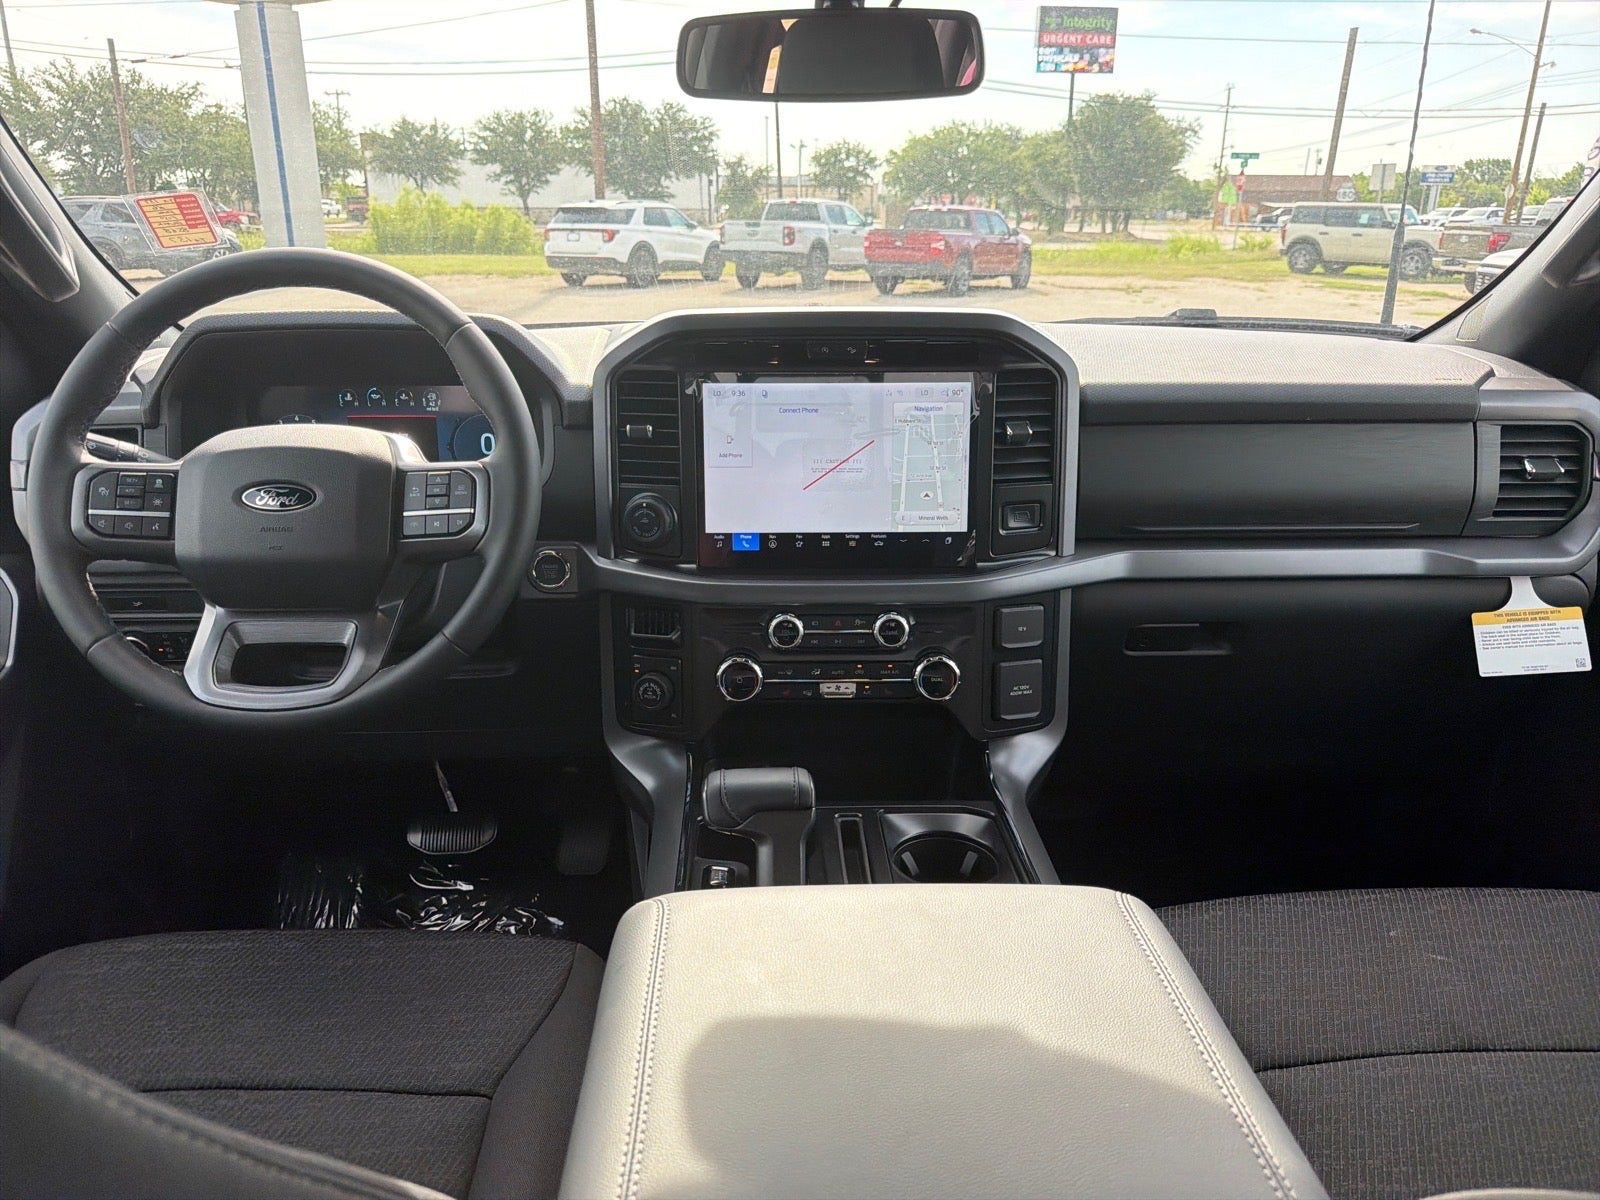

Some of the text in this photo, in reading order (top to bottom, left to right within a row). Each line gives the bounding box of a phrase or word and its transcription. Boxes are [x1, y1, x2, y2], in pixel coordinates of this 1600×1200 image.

[1063, 15, 1112, 31] Integrity
[1043, 32, 1112, 45] URGENT CARE
[914, 405, 944, 413] Navigation
[481, 432, 496, 455] 0
[255, 488, 300, 506] Ford
[845, 533, 860, 541] Settings
